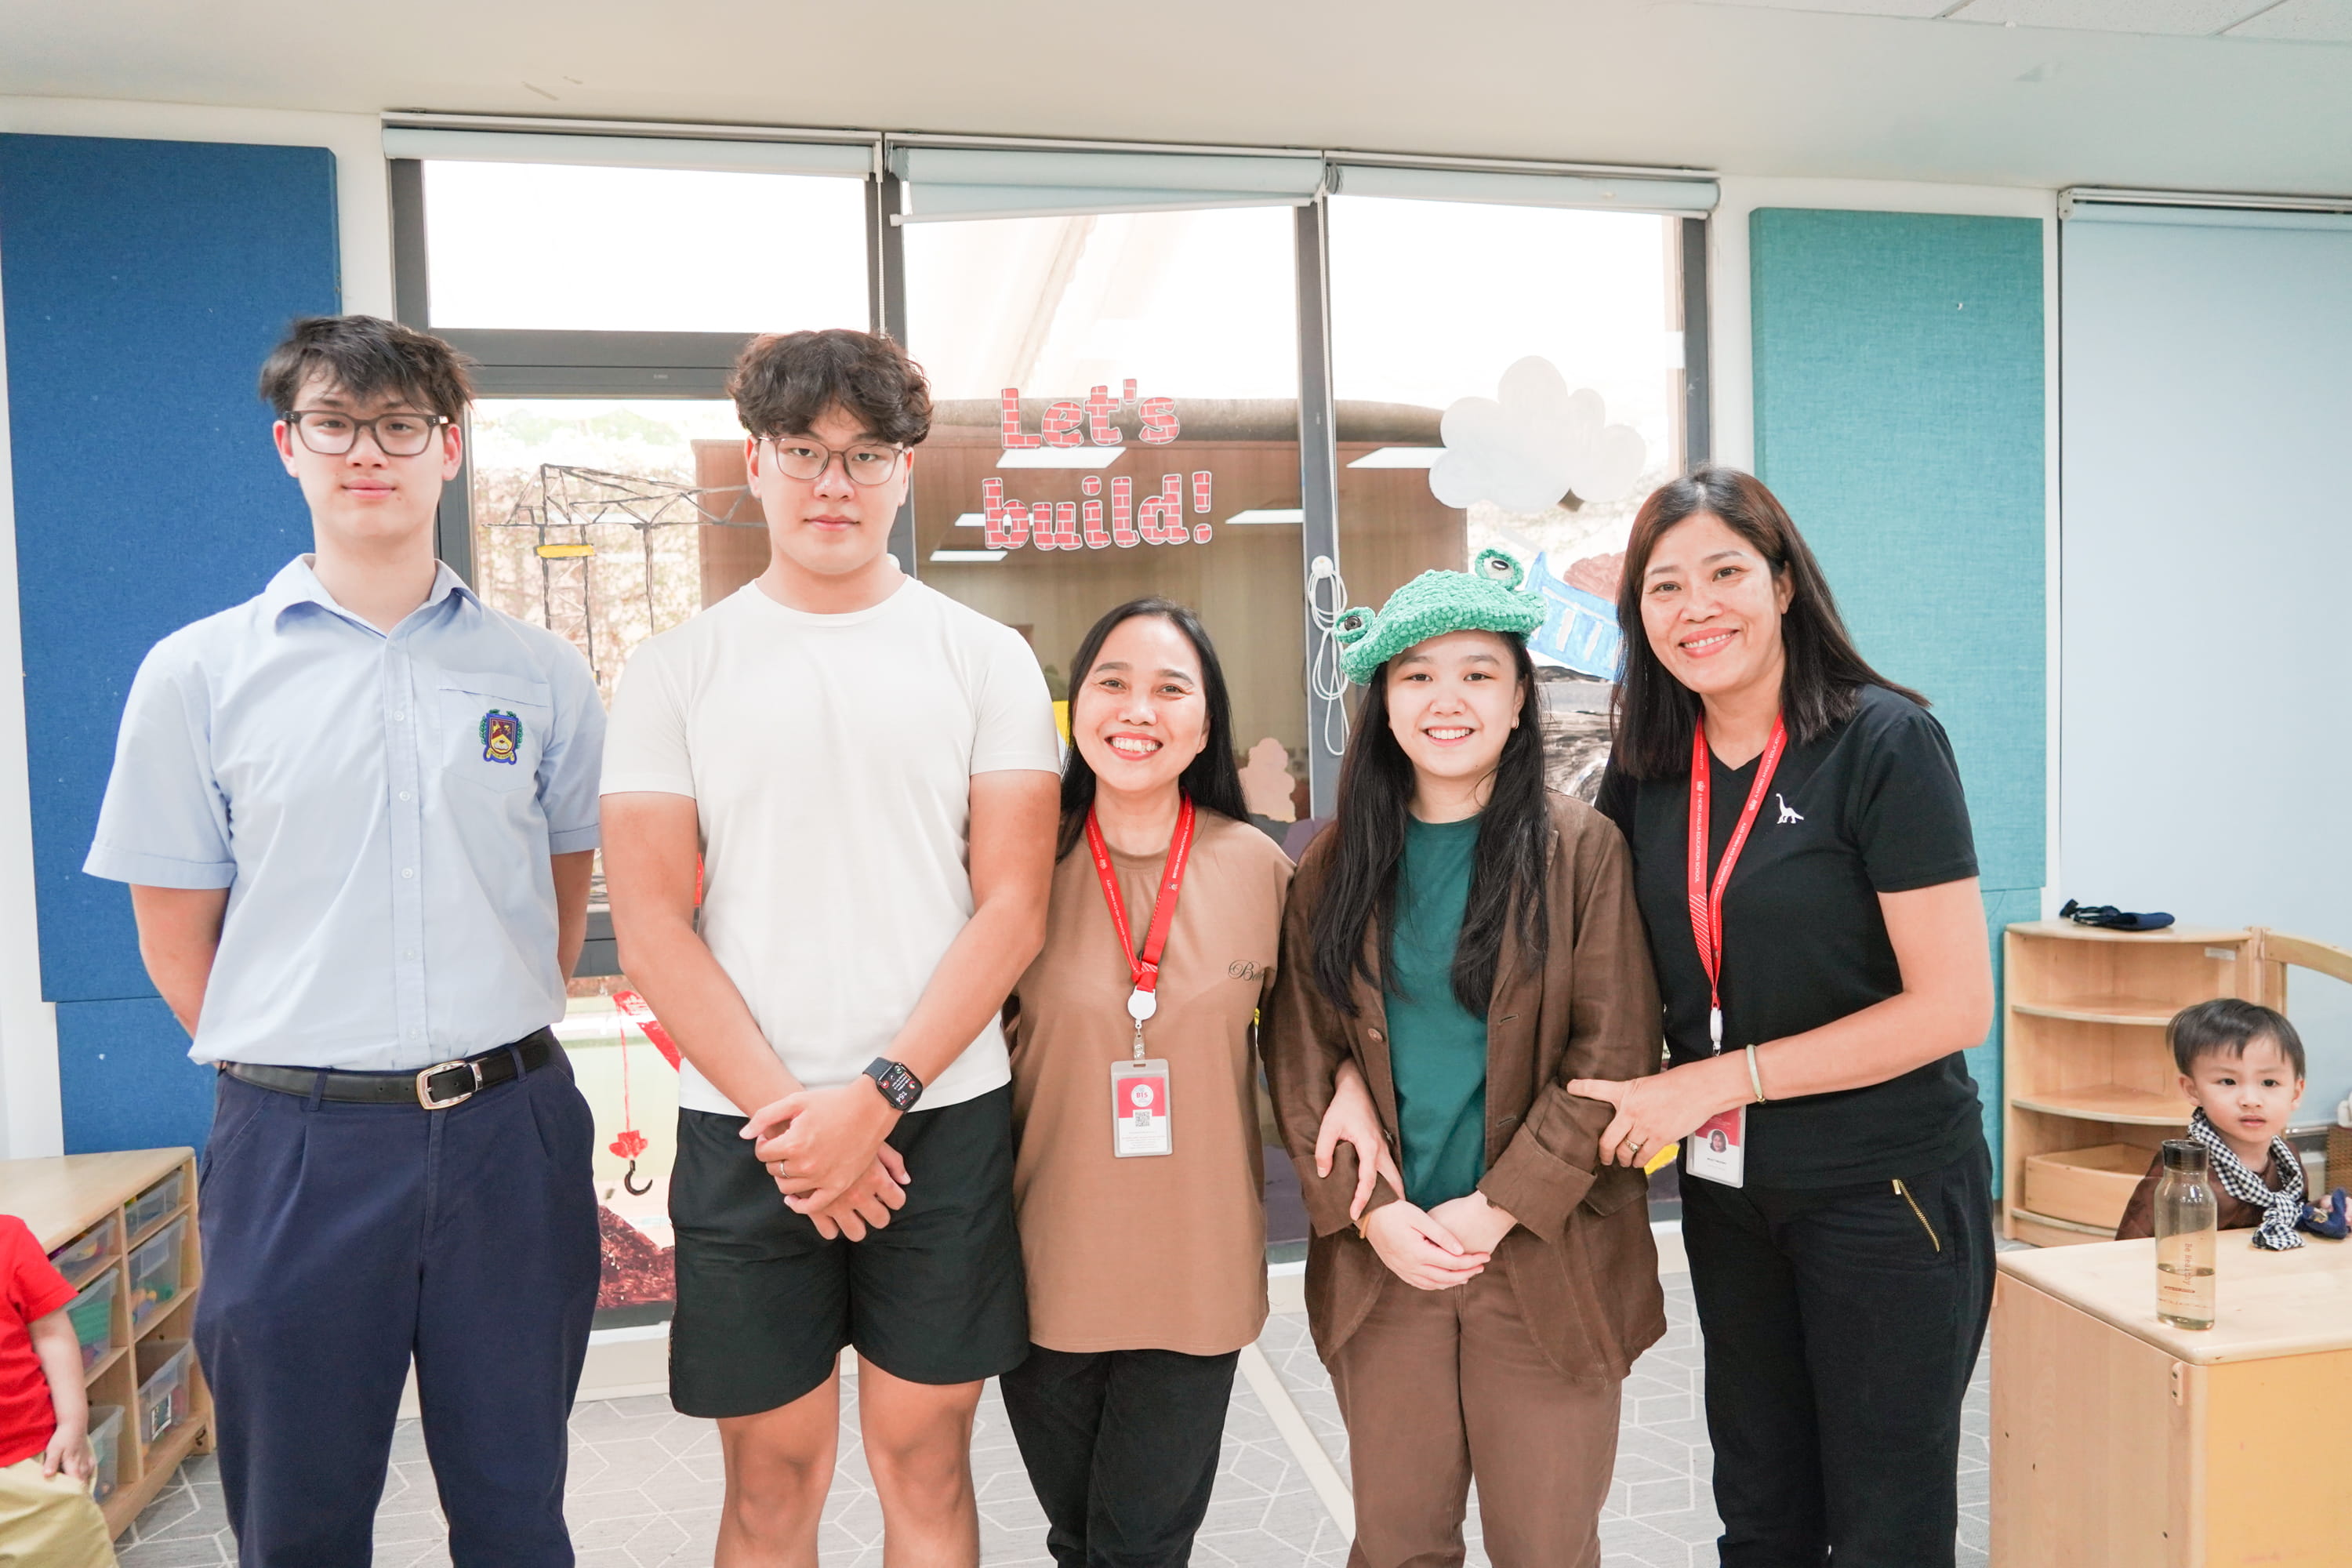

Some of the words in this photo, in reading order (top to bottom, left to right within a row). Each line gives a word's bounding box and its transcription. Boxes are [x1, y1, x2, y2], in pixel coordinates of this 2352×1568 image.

[1001, 379, 1180, 449] Let's
[982, 471, 1212, 550] build!
[1756, 779, 1765, 793] NORD
[1762, 760, 1772, 778] ANGLIA
[1769, 728, 1783, 758] EDUCATION
[1177, 831, 1188, 862] INTERNATIONAL
